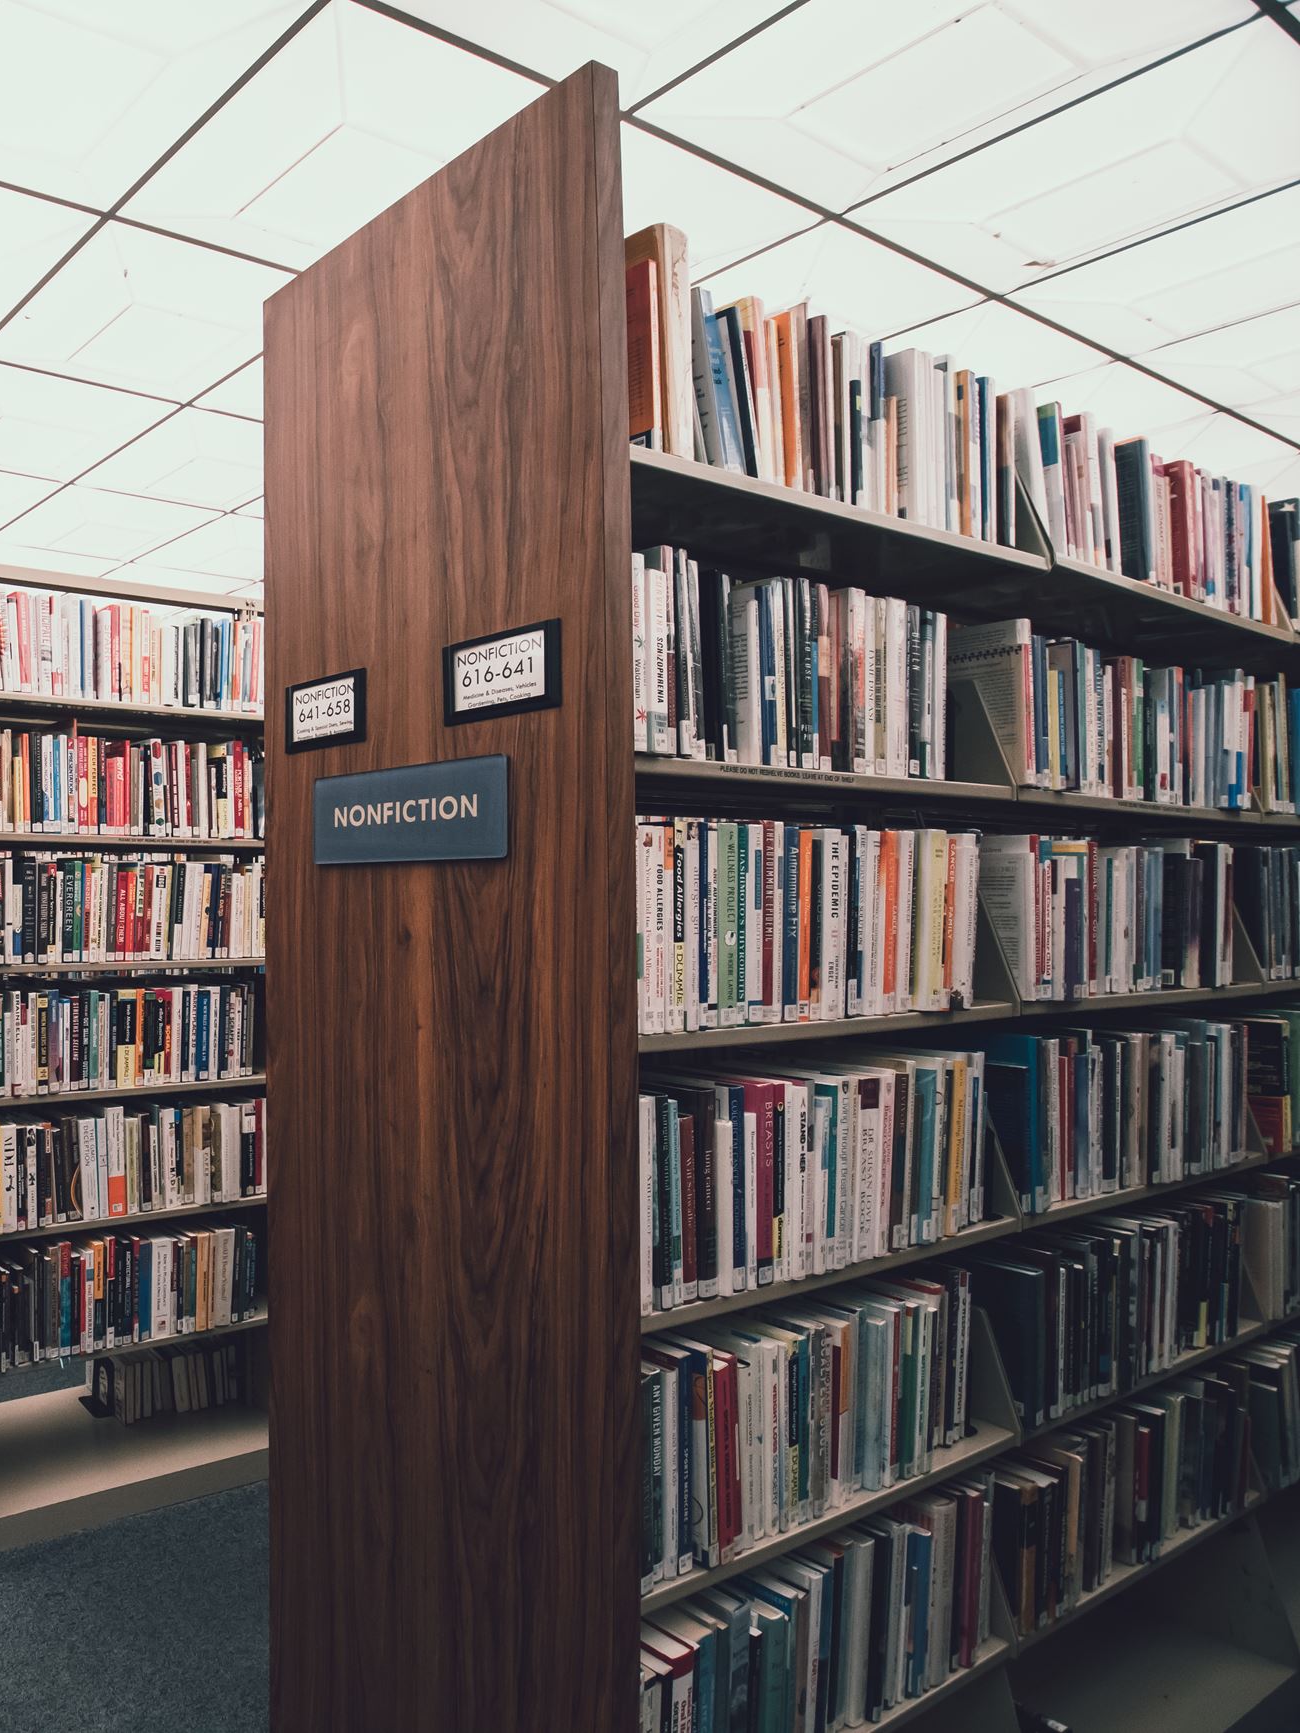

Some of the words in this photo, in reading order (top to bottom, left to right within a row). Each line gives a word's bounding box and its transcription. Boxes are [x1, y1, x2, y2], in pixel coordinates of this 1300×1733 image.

[456, 636, 543, 668] NONFICTION
[656, 636, 664, 704] SCHIZOPHRENIA
[462, 656, 533, 688] 616-641
[634, 658, 643, 699] Waldman
[295, 683, 354, 706] NONFICTION
[299, 698, 351, 723] 641-658
[720, 765, 739, 774] PLEASE
[740, 766, 747, 774] DO
[748, 767, 759, 775] NOT
[760, 768, 783, 778] RESHELVE
[334, 793, 479, 829] NONFICTION
[675, 852, 684, 882] Food
[726, 843, 736, 883] WELLNESS
[831, 841, 840, 862] THE
[949, 842, 958, 884] CANCER
[788, 846, 800, 914] Autoimmune
[830, 864, 840, 919] EPIDEMIC
[65, 874, 73, 932] EVERGREEN
[656, 887, 664, 931] ALLERGIES
[675, 883, 684, 938] Allergies
[726, 885, 736, 923] PROJECT
[82, 1125, 90, 1168] DECEPTION
[764, 1101, 773, 1168] BREASTS
[840, 1162, 848, 1197] Breast
[839, 1199, 847, 1233] Cancer
[652, 1384, 661, 1404] ANY
[652, 1406, 661, 1435] GIVEN
